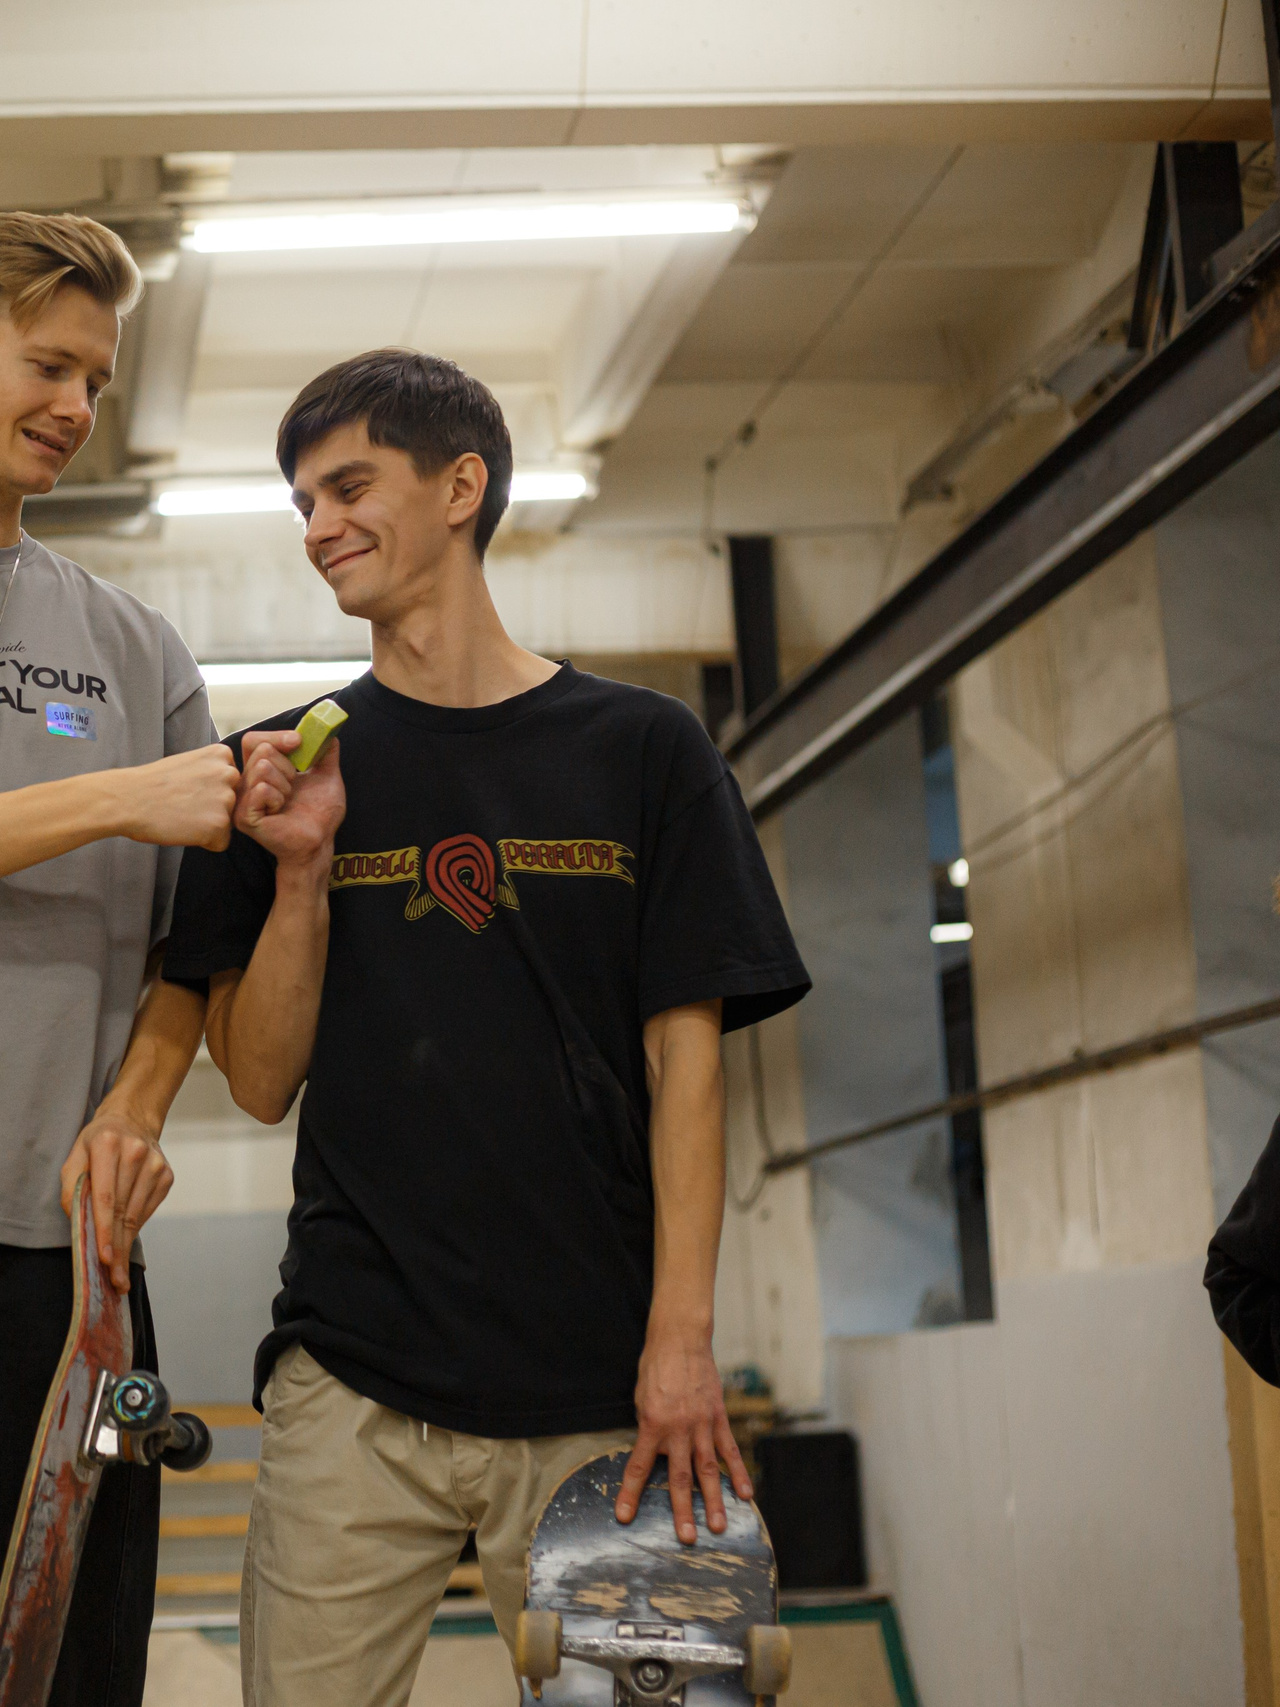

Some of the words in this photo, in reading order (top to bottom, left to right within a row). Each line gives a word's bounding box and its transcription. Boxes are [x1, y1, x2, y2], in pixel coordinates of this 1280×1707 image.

[9, 659, 107, 704] YOUR
[53, 711, 90, 726] SURFING
[329, 850, 415, 882] OWELL
[503, 841, 614, 871] PERALTA
